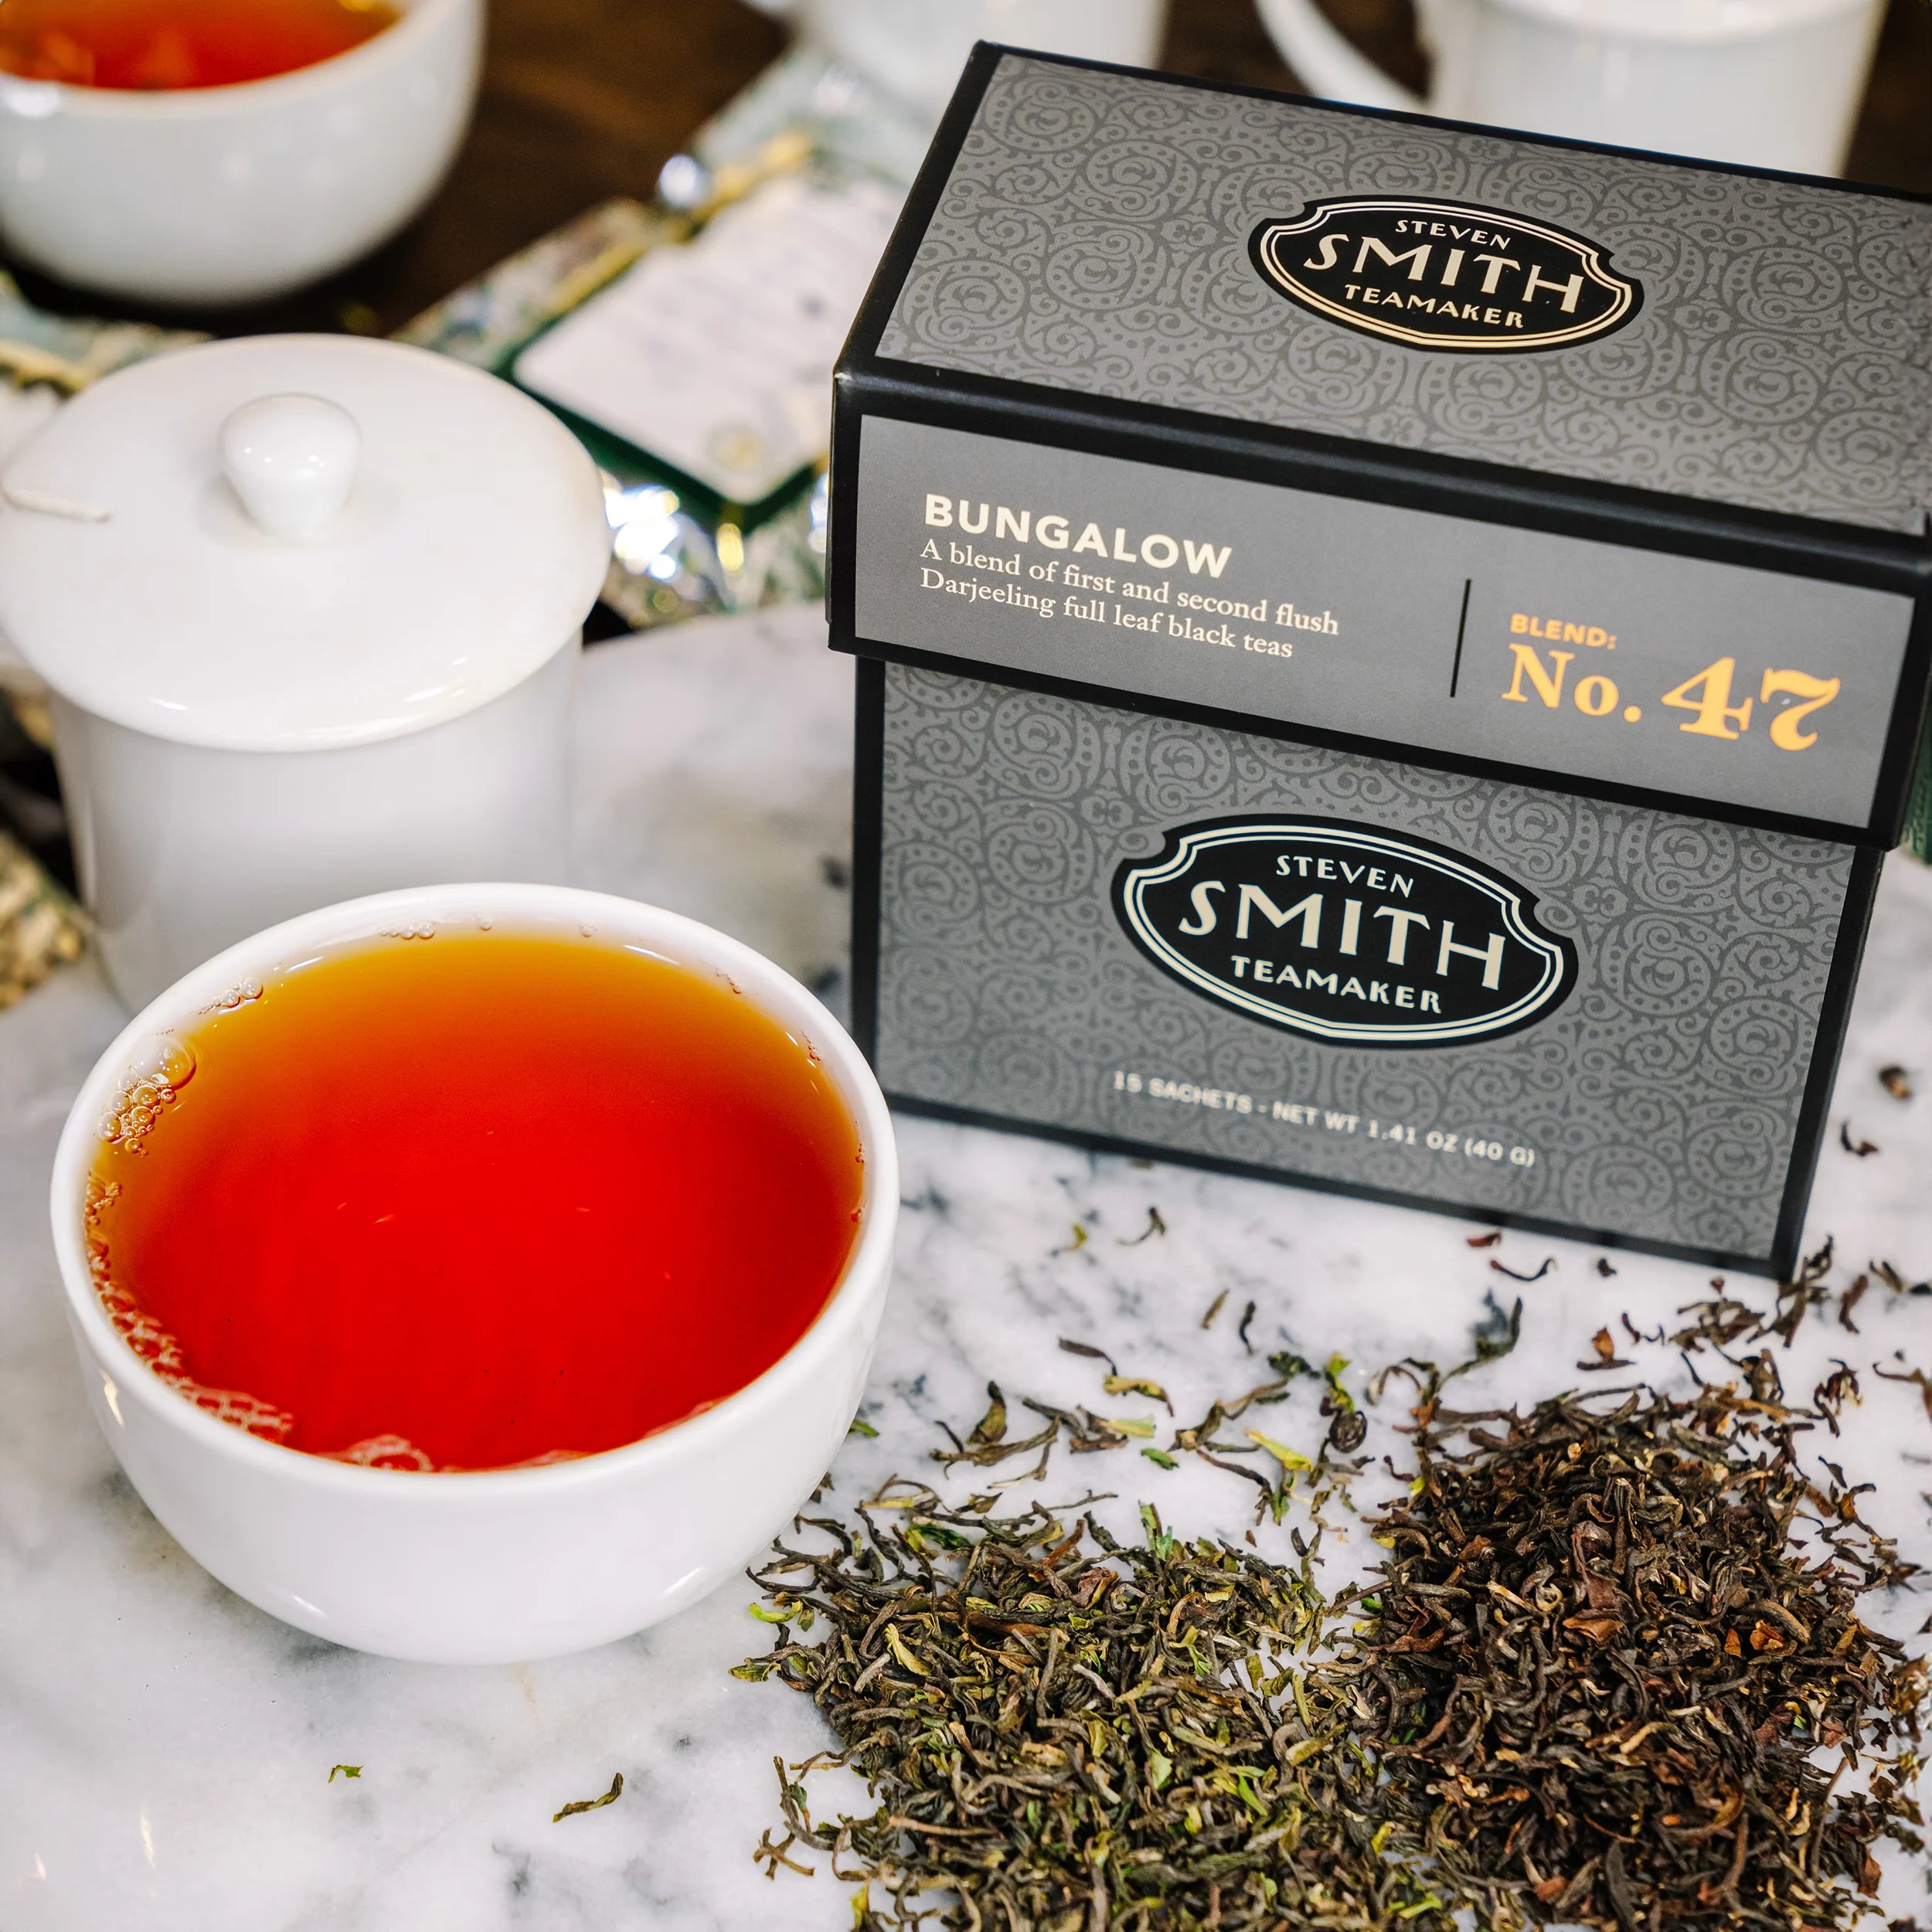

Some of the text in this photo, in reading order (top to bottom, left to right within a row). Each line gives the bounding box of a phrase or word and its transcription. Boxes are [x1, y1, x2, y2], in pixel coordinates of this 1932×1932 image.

[1303, 233, 1585, 313] SMITH
[1396, 219, 1511, 250] STEVEN
[1344, 284, 1524, 328] TEAMAKER
[925, 493, 1233, 578] BUNGALOW
[920, 538, 1339, 636] A blend of first and second flush
[920, 566, 1293, 658] Darjeeling full leaf black teas
[1510, 613, 1617, 649] BLEND:
[1501, 642, 1841, 751] No. 47
[1276, 855, 1414, 898] STEVEN
[1178, 880, 1506, 991] SMITH
[1230, 955, 1442, 1014] TEAMAKER
[1113, 1070, 1143, 1094] 15
[1148, 1077, 1253, 1115] SACHETS
[1272, 1100, 1321, 1127] NET
[1322, 1110, 1360, 1134] WT
[1367, 1118, 1417, 1146] 1.41
[1425, 1129, 1459, 1153] OZ
[1464, 1137, 1504, 1161] (40
[1509, 1145, 1536, 1169] G)
